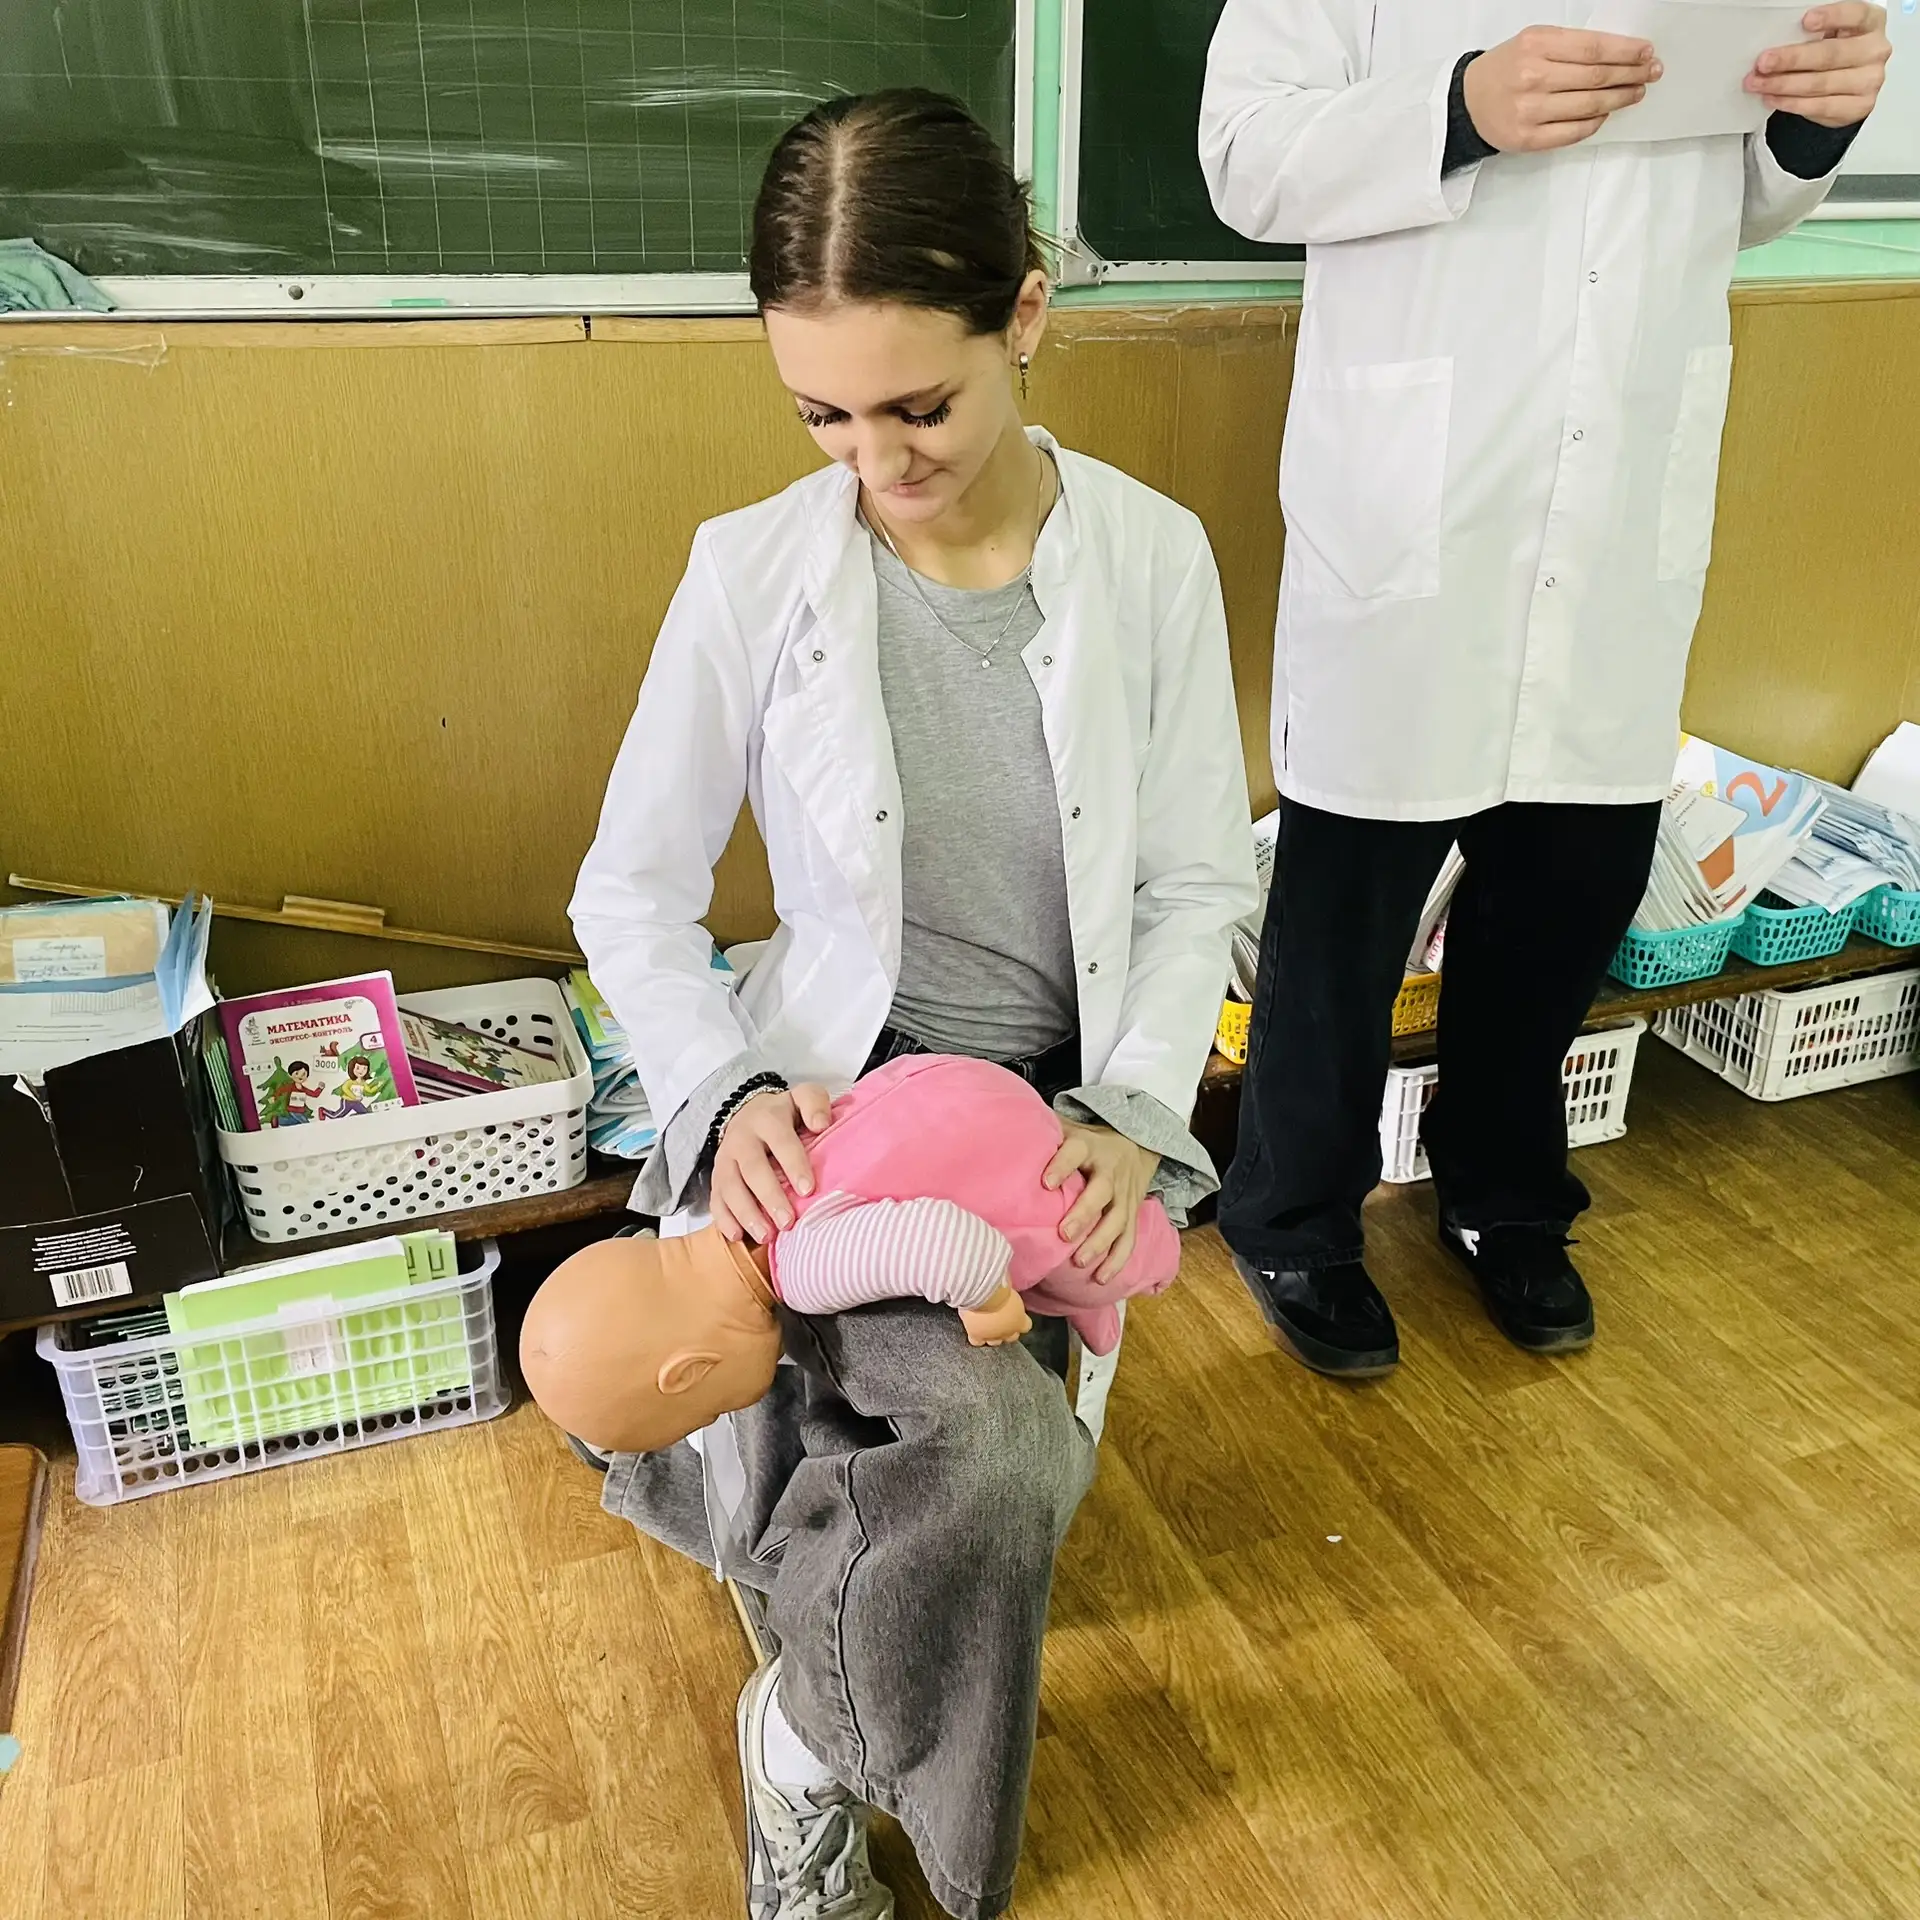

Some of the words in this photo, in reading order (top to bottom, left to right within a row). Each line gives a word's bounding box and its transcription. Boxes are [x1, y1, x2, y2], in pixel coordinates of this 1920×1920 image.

[1726, 771, 1788, 817] 2
[267, 1013, 352, 1035] МАТЕМАТИКА
[269, 1026, 353, 1045] ЭКСПРЕСС-КОНТРОЛЬ
[370, 1035, 378, 1043] 4
[315, 1059, 337, 1070] 3000
